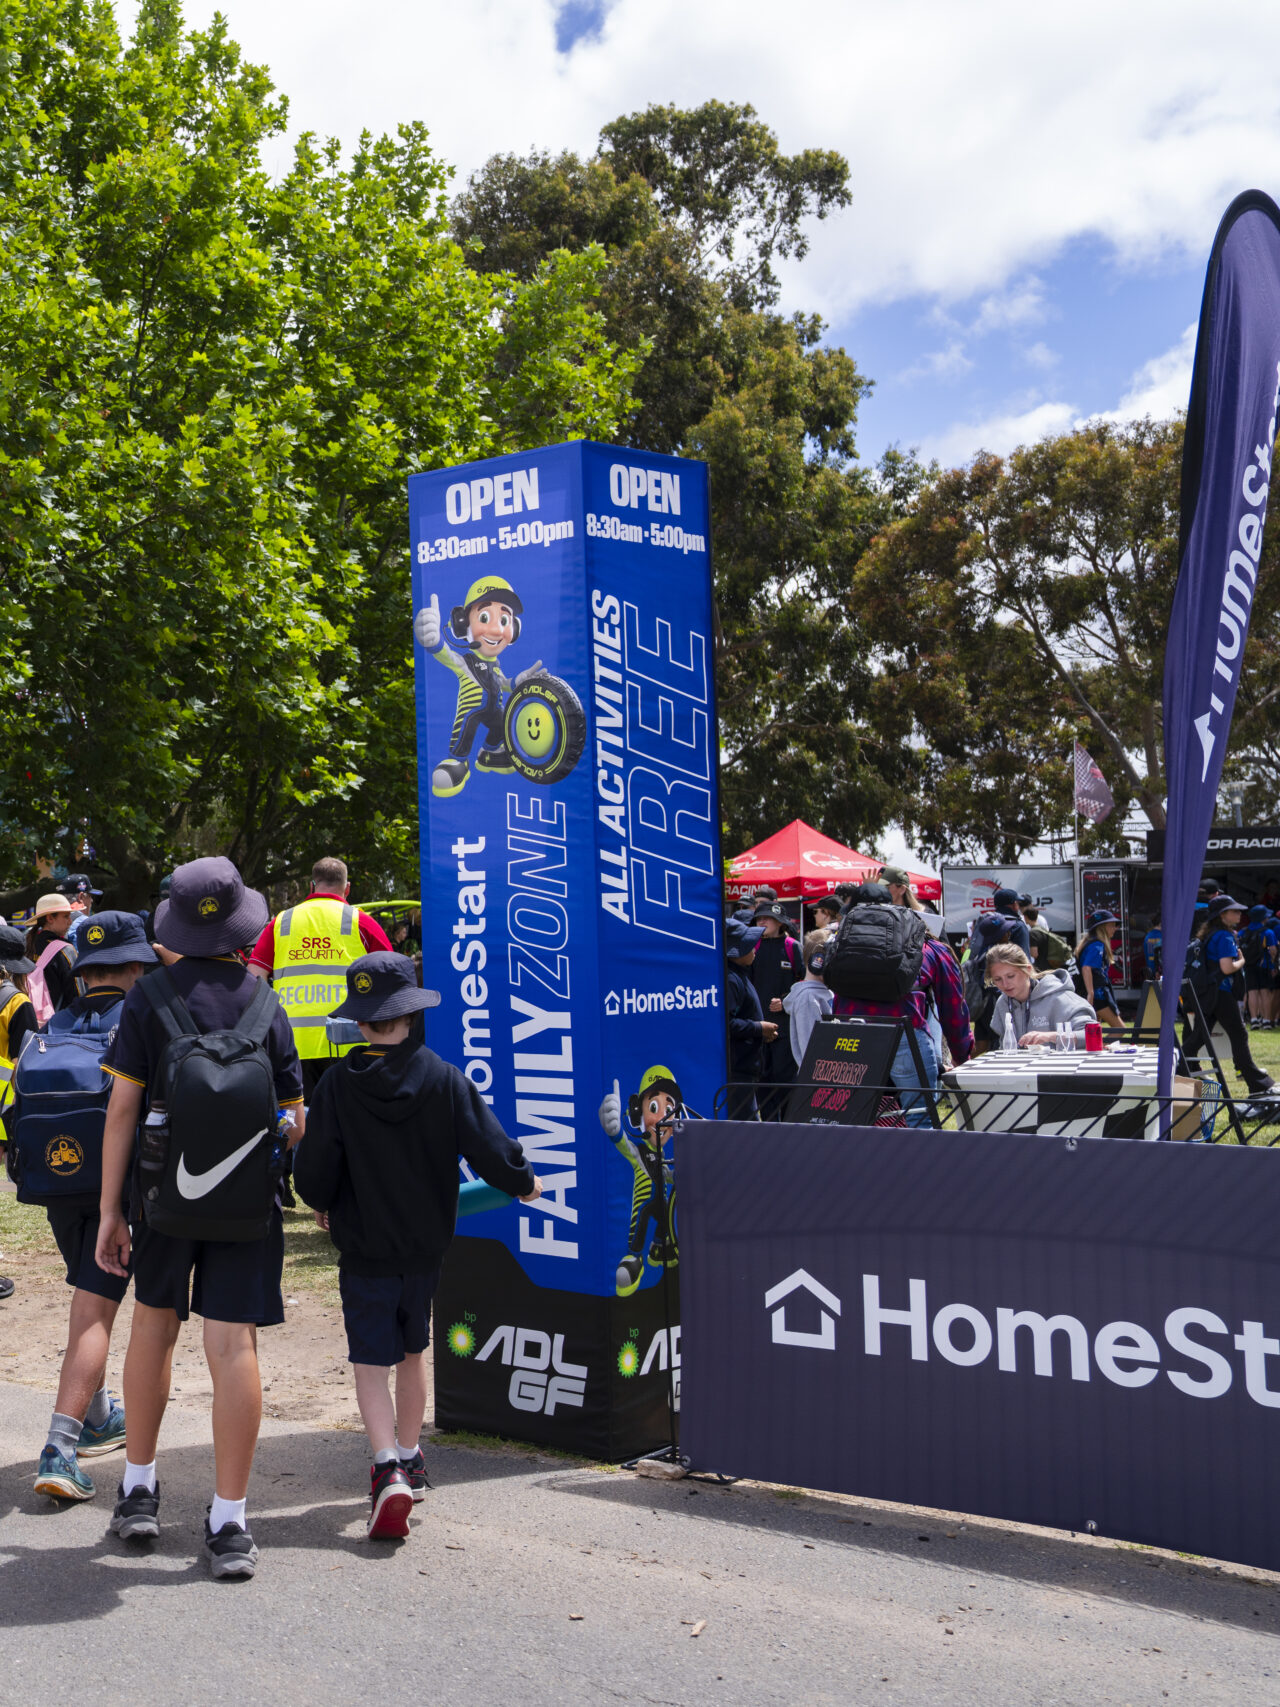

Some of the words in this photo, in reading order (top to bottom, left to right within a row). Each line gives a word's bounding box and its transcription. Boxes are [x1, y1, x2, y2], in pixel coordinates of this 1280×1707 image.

[445, 466, 540, 525] OPEN
[609, 463, 682, 516] OPEN
[591, 589, 626, 838] ACTIVITIES
[623, 600, 717, 950] FREE
[1235, 837, 1280, 849] RACI
[600, 846, 630, 924] ALL
[288, 949, 345, 960] SECURITY
[301, 937, 331, 949] SRS
[450, 836, 495, 1105] omeStart
[278, 984, 348, 1006] SECURIT
[623, 984, 718, 1015] HomeStart
[834, 1037, 860, 1052] FREE
[464, 1310, 477, 1323] bp
[629, 1327, 640, 1338] bp
[474, 1325, 588, 1379] ADL
[508, 1368, 586, 1416] GF
